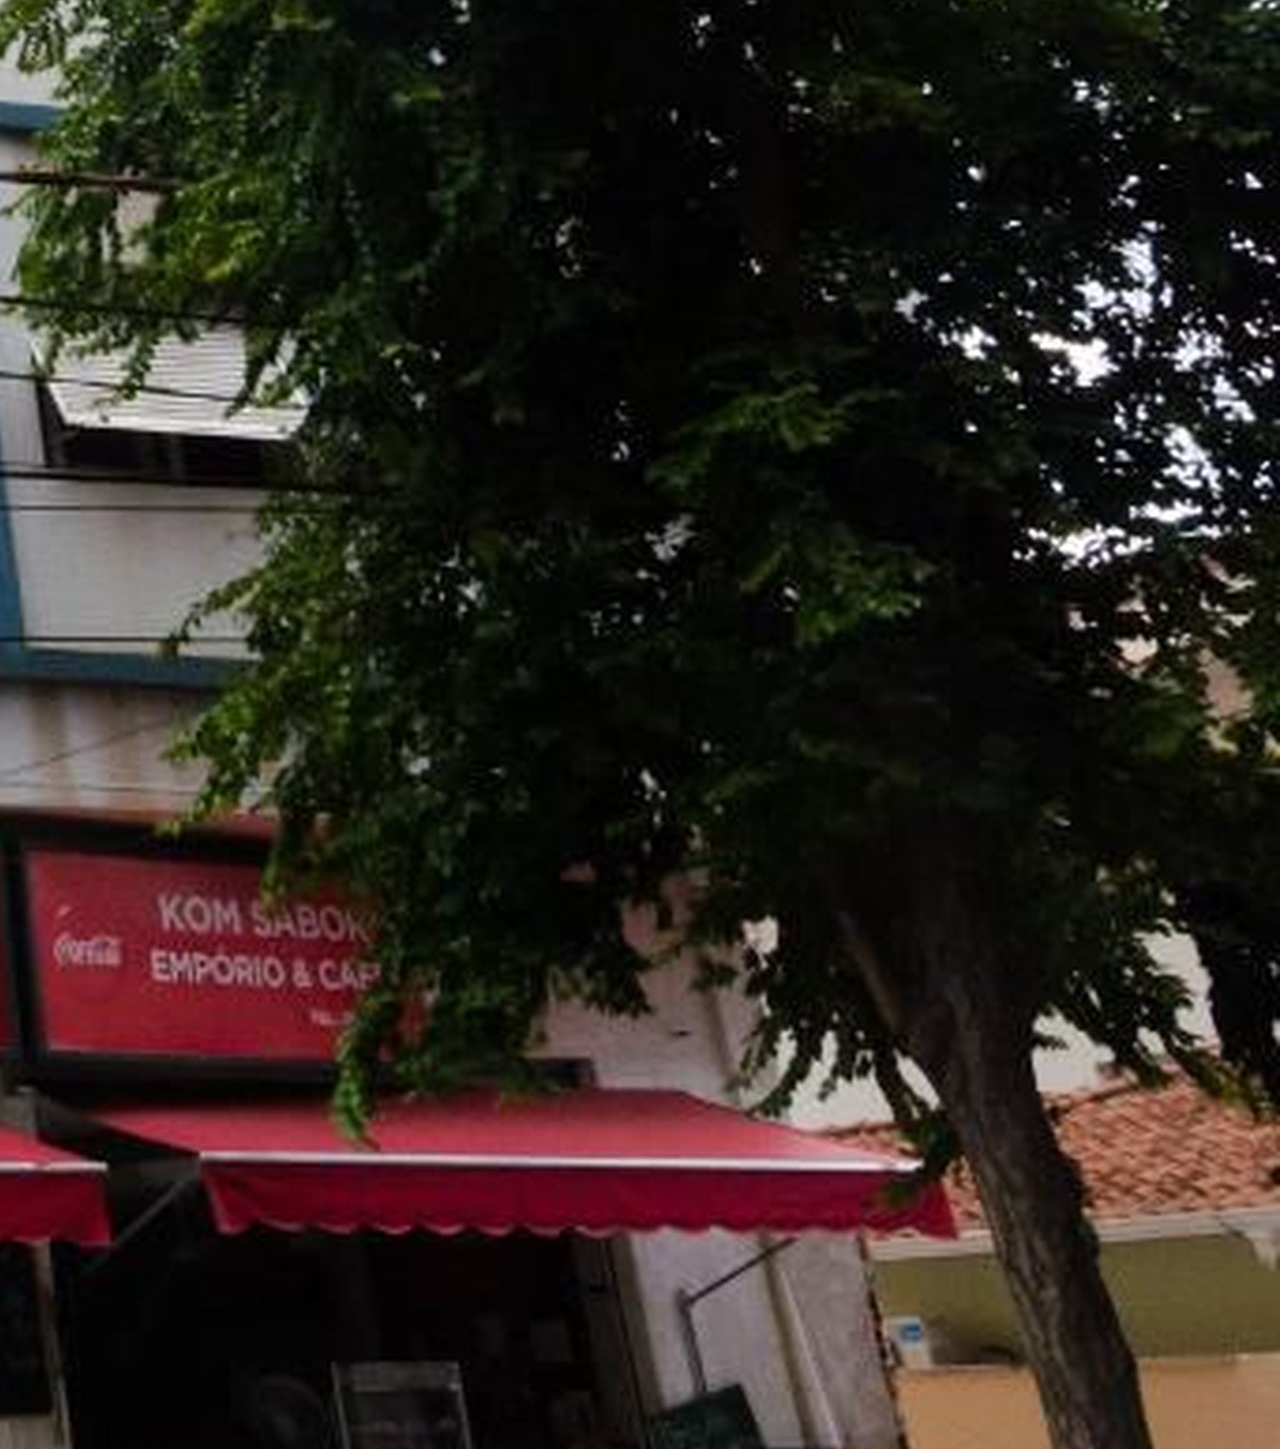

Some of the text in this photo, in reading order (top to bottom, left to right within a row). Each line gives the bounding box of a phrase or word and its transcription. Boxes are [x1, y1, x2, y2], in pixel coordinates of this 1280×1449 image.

[157, 893, 241, 934] KOM
[149, 944, 286, 988] EMPÓRIO
[292, 959, 313, 988] &
